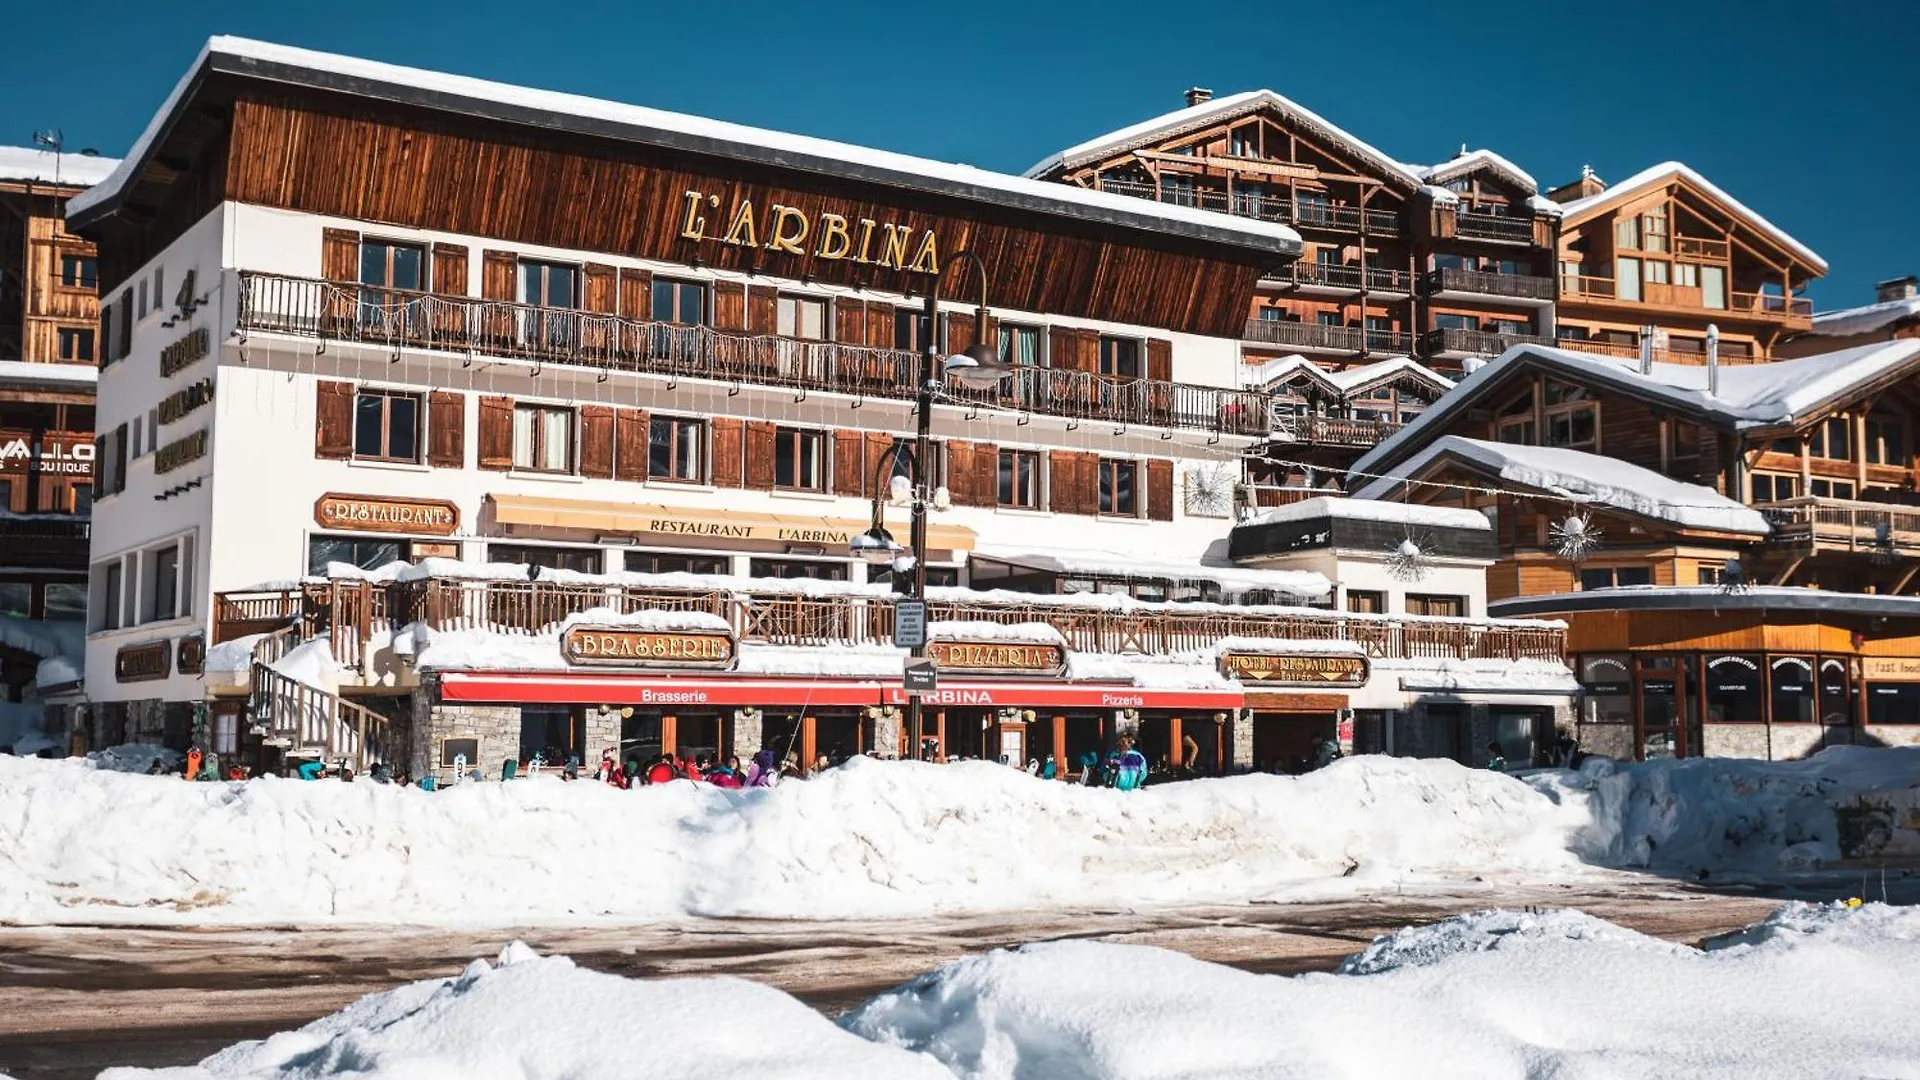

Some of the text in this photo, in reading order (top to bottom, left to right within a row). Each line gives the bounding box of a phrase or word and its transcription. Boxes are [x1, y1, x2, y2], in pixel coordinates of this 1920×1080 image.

[682, 190, 939, 275] L'ARBINA
[335, 502, 444, 526] RESTAURANT
[650, 519, 849, 543] RESTAURANT L'ARBINA
[582, 635, 721, 658] BRASSERIE
[949, 645, 1043, 666] PIZZERIA
[1229, 656, 1358, 672] HOTEL RESTAURANT
[642, 688, 707, 703] Brasserie
[893, 689, 993, 704] LRBINA
[1102, 693, 1144, 707] Pizzeria
